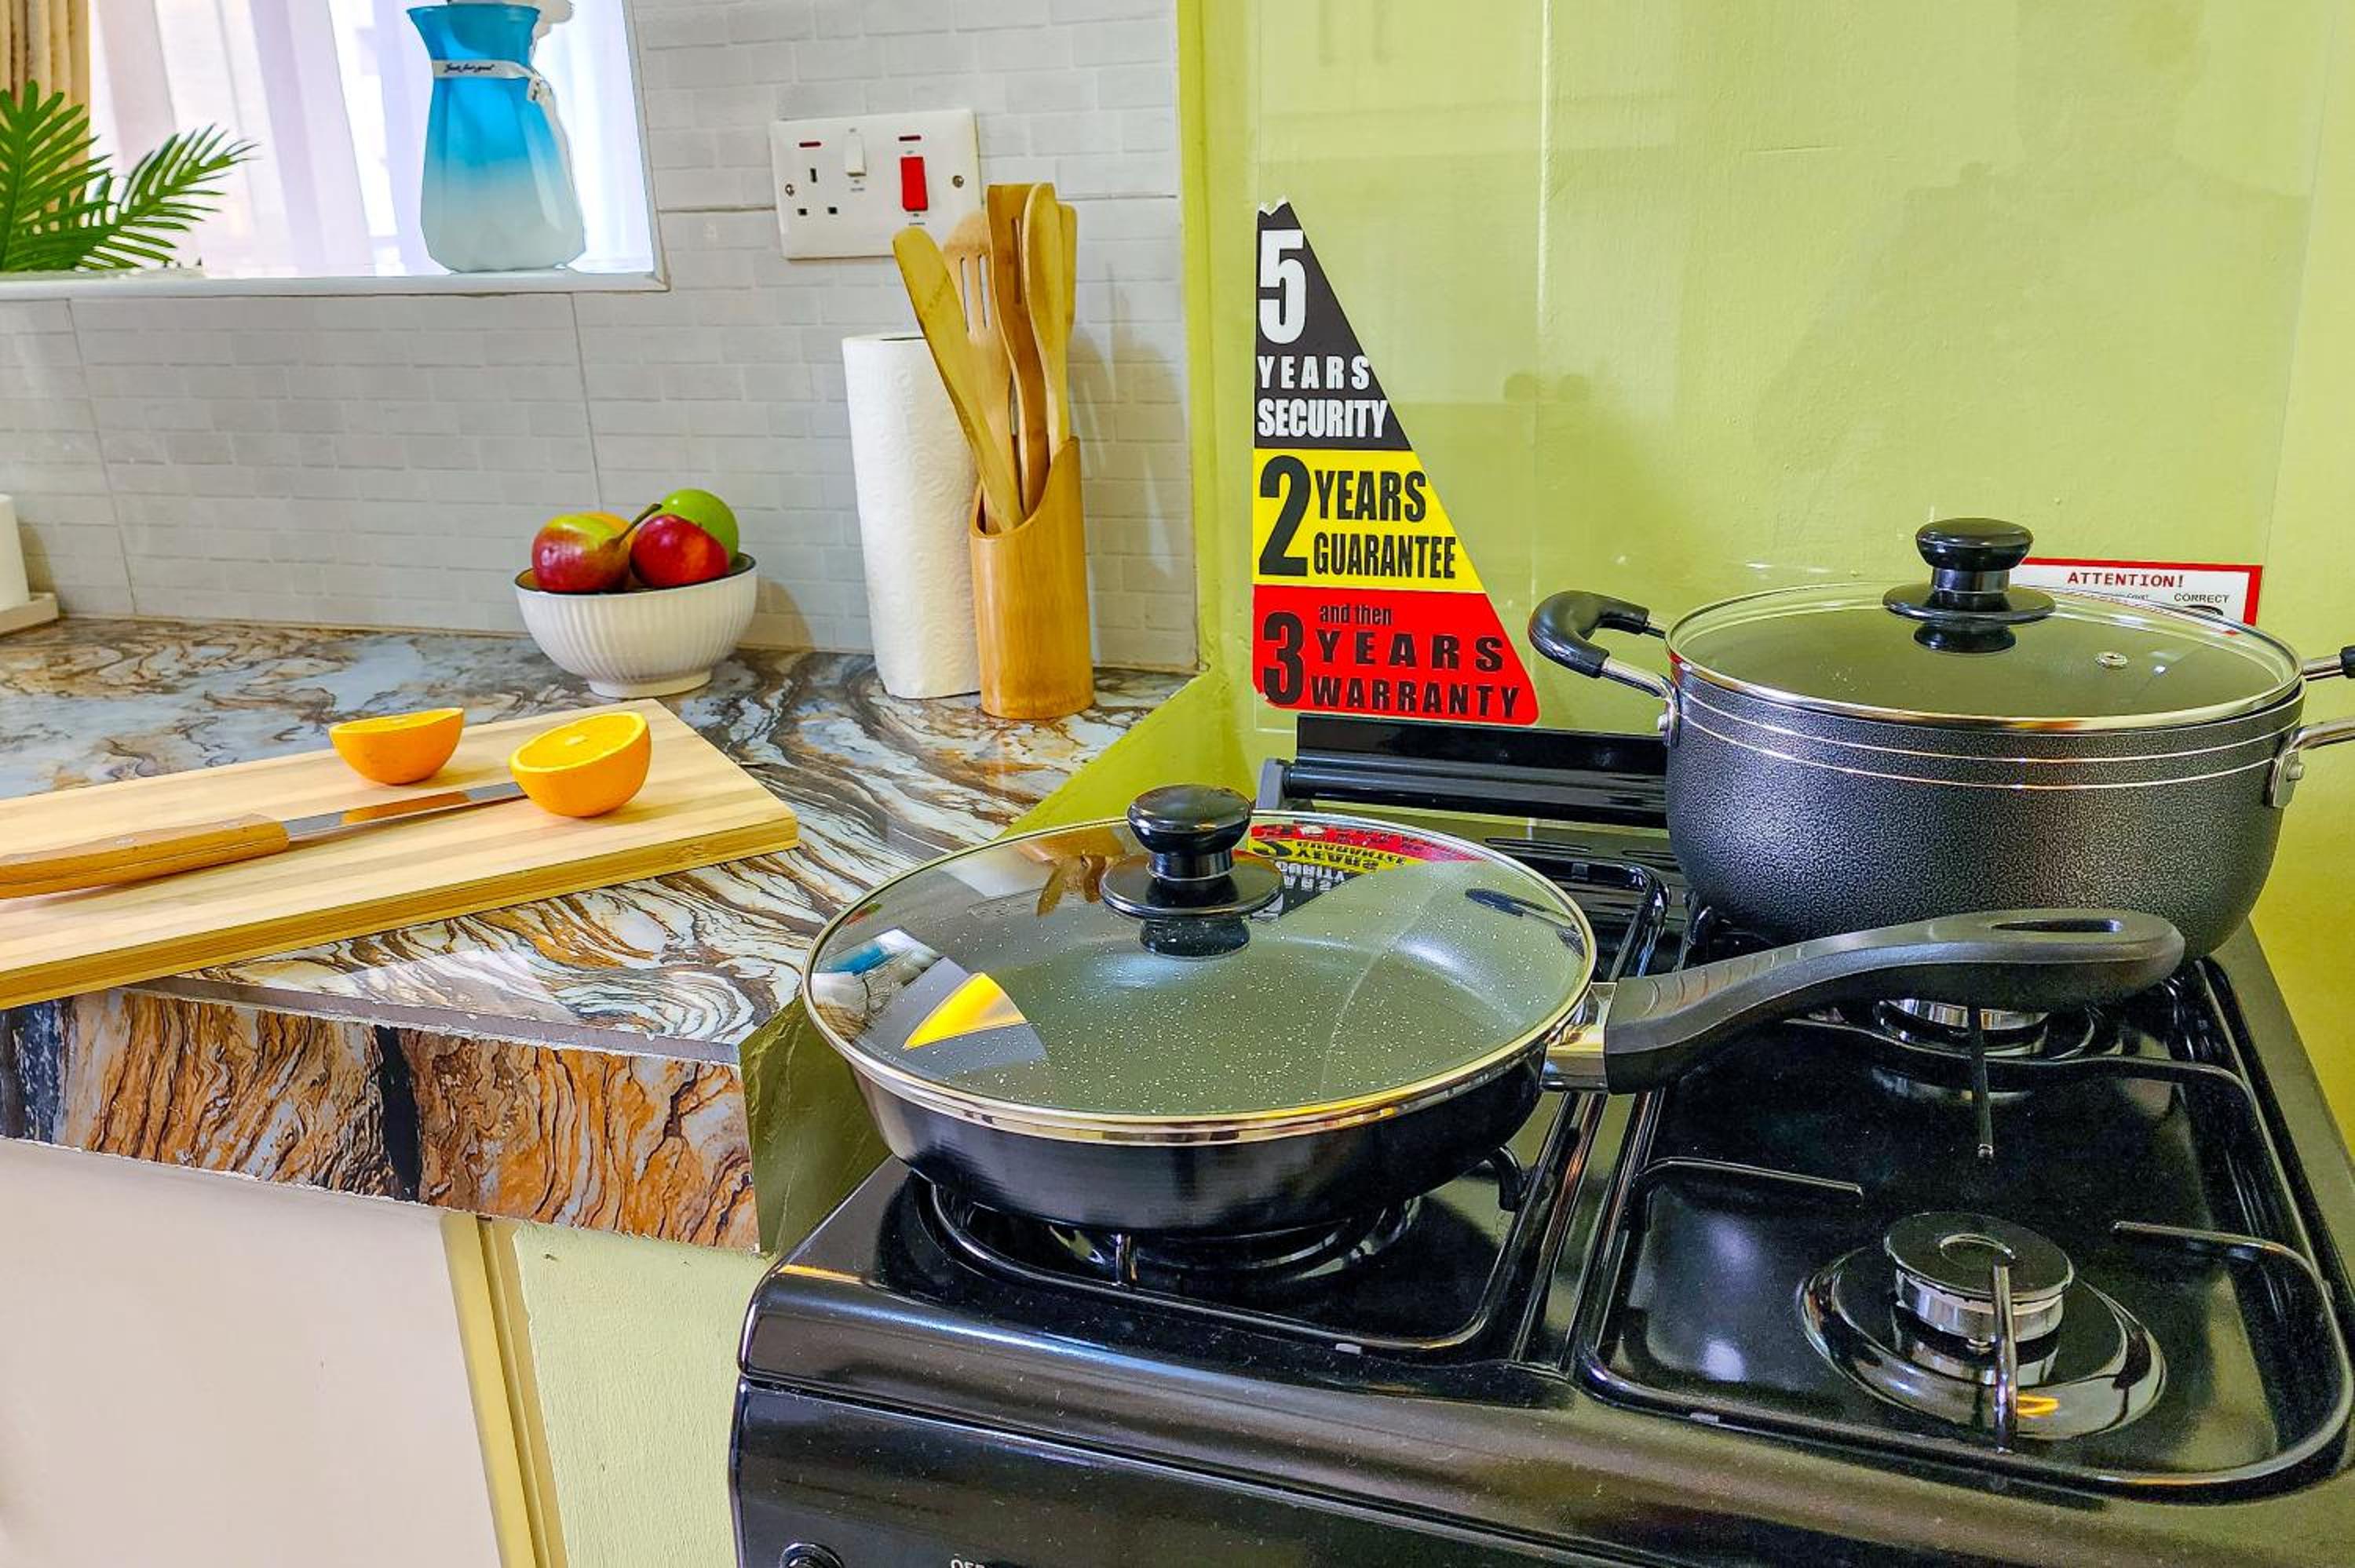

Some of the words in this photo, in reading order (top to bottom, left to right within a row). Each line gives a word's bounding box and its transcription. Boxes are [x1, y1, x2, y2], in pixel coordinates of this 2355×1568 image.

[1258, 229, 1306, 345] 5
[1258, 355, 1370, 391] YEARS
[1258, 398, 1387, 438] SECURITY
[1259, 455, 1311, 577] 2
[1314, 470, 1427, 523] YEARS
[1313, 531, 1456, 578] GUARANTEE
[2067, 572, 2185, 589] ATTENTION!
[2174, 593, 2230, 604] CORRECT
[1320, 603, 1350, 624] and
[1356, 605, 1393, 625] then
[1263, 611, 1304, 706] 3
[1316, 629, 1505, 673] YEARS
[1311, 676, 1520, 719] WARRANTY
